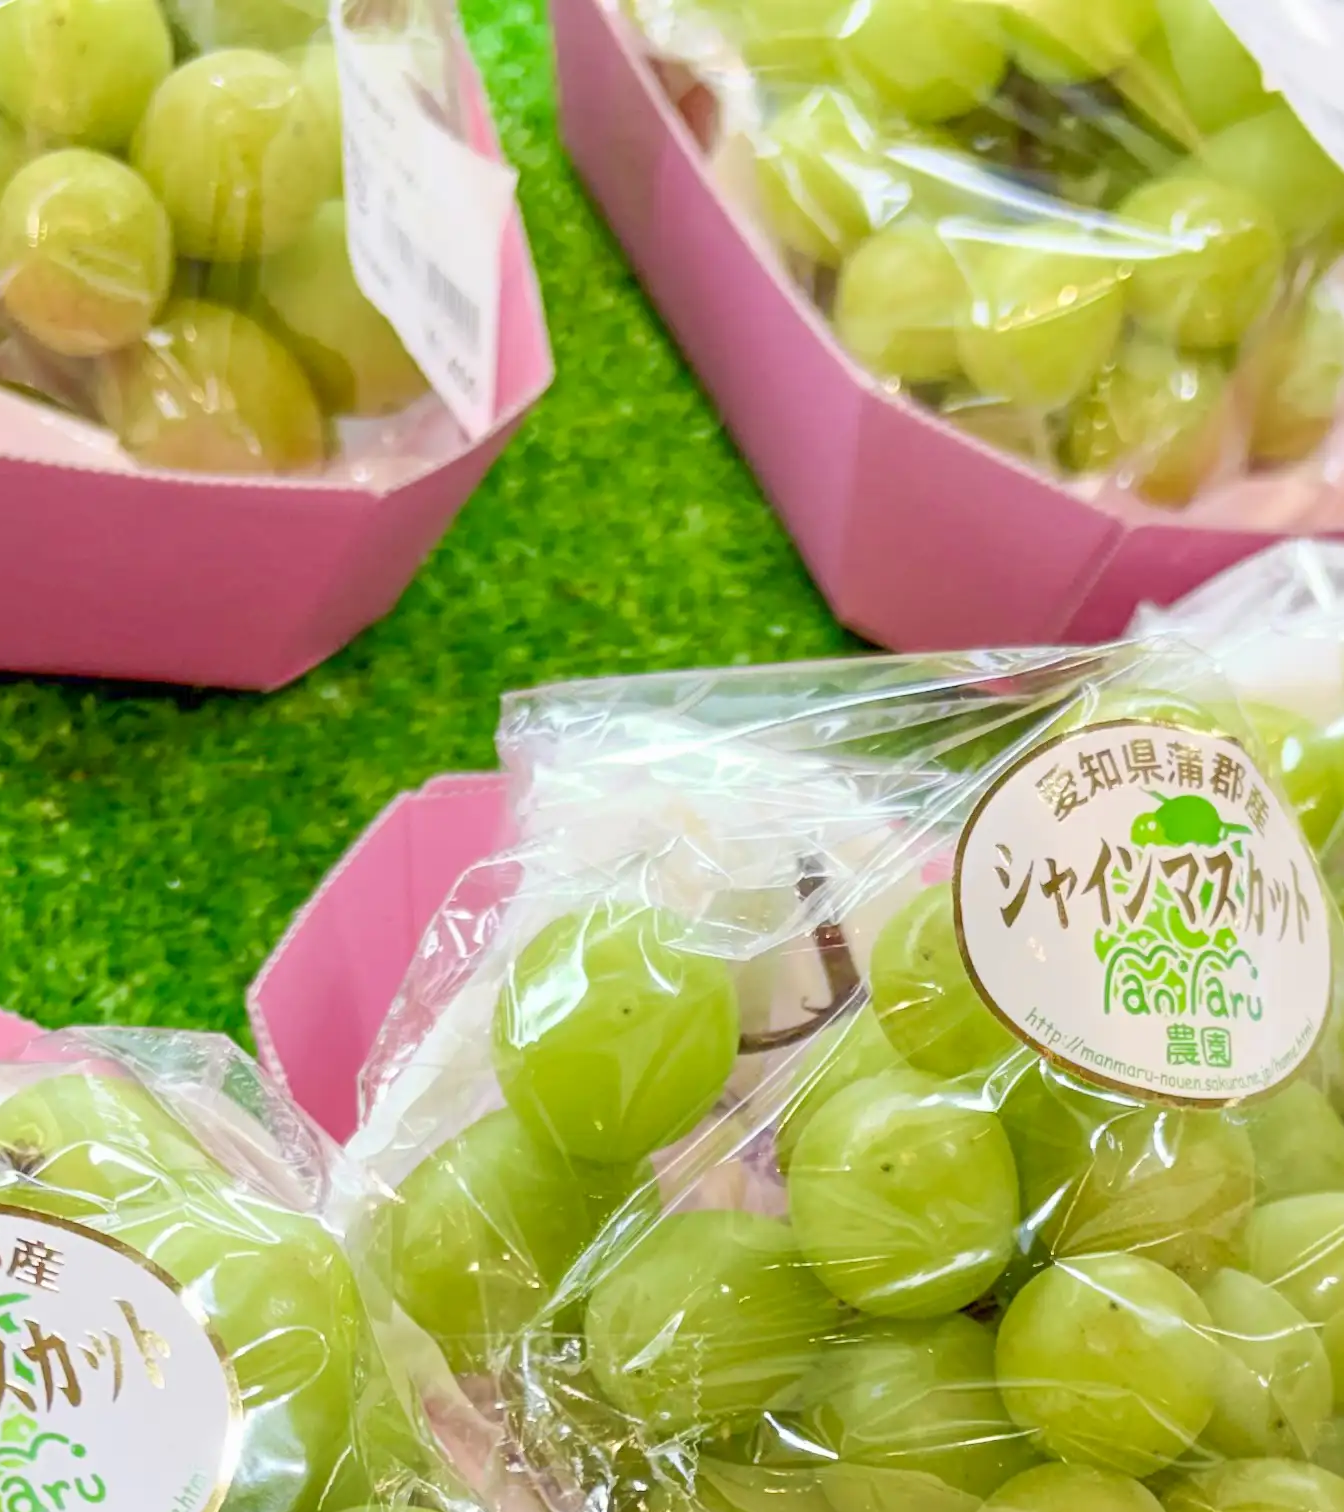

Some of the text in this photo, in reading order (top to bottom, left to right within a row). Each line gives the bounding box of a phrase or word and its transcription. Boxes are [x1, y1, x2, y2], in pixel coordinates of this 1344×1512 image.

[1035, 737, 1271, 838] 愛知県蒲郡産
[993, 836, 1312, 945] シャインマスカット
[1166, 1023, 1232, 1068] 農園
